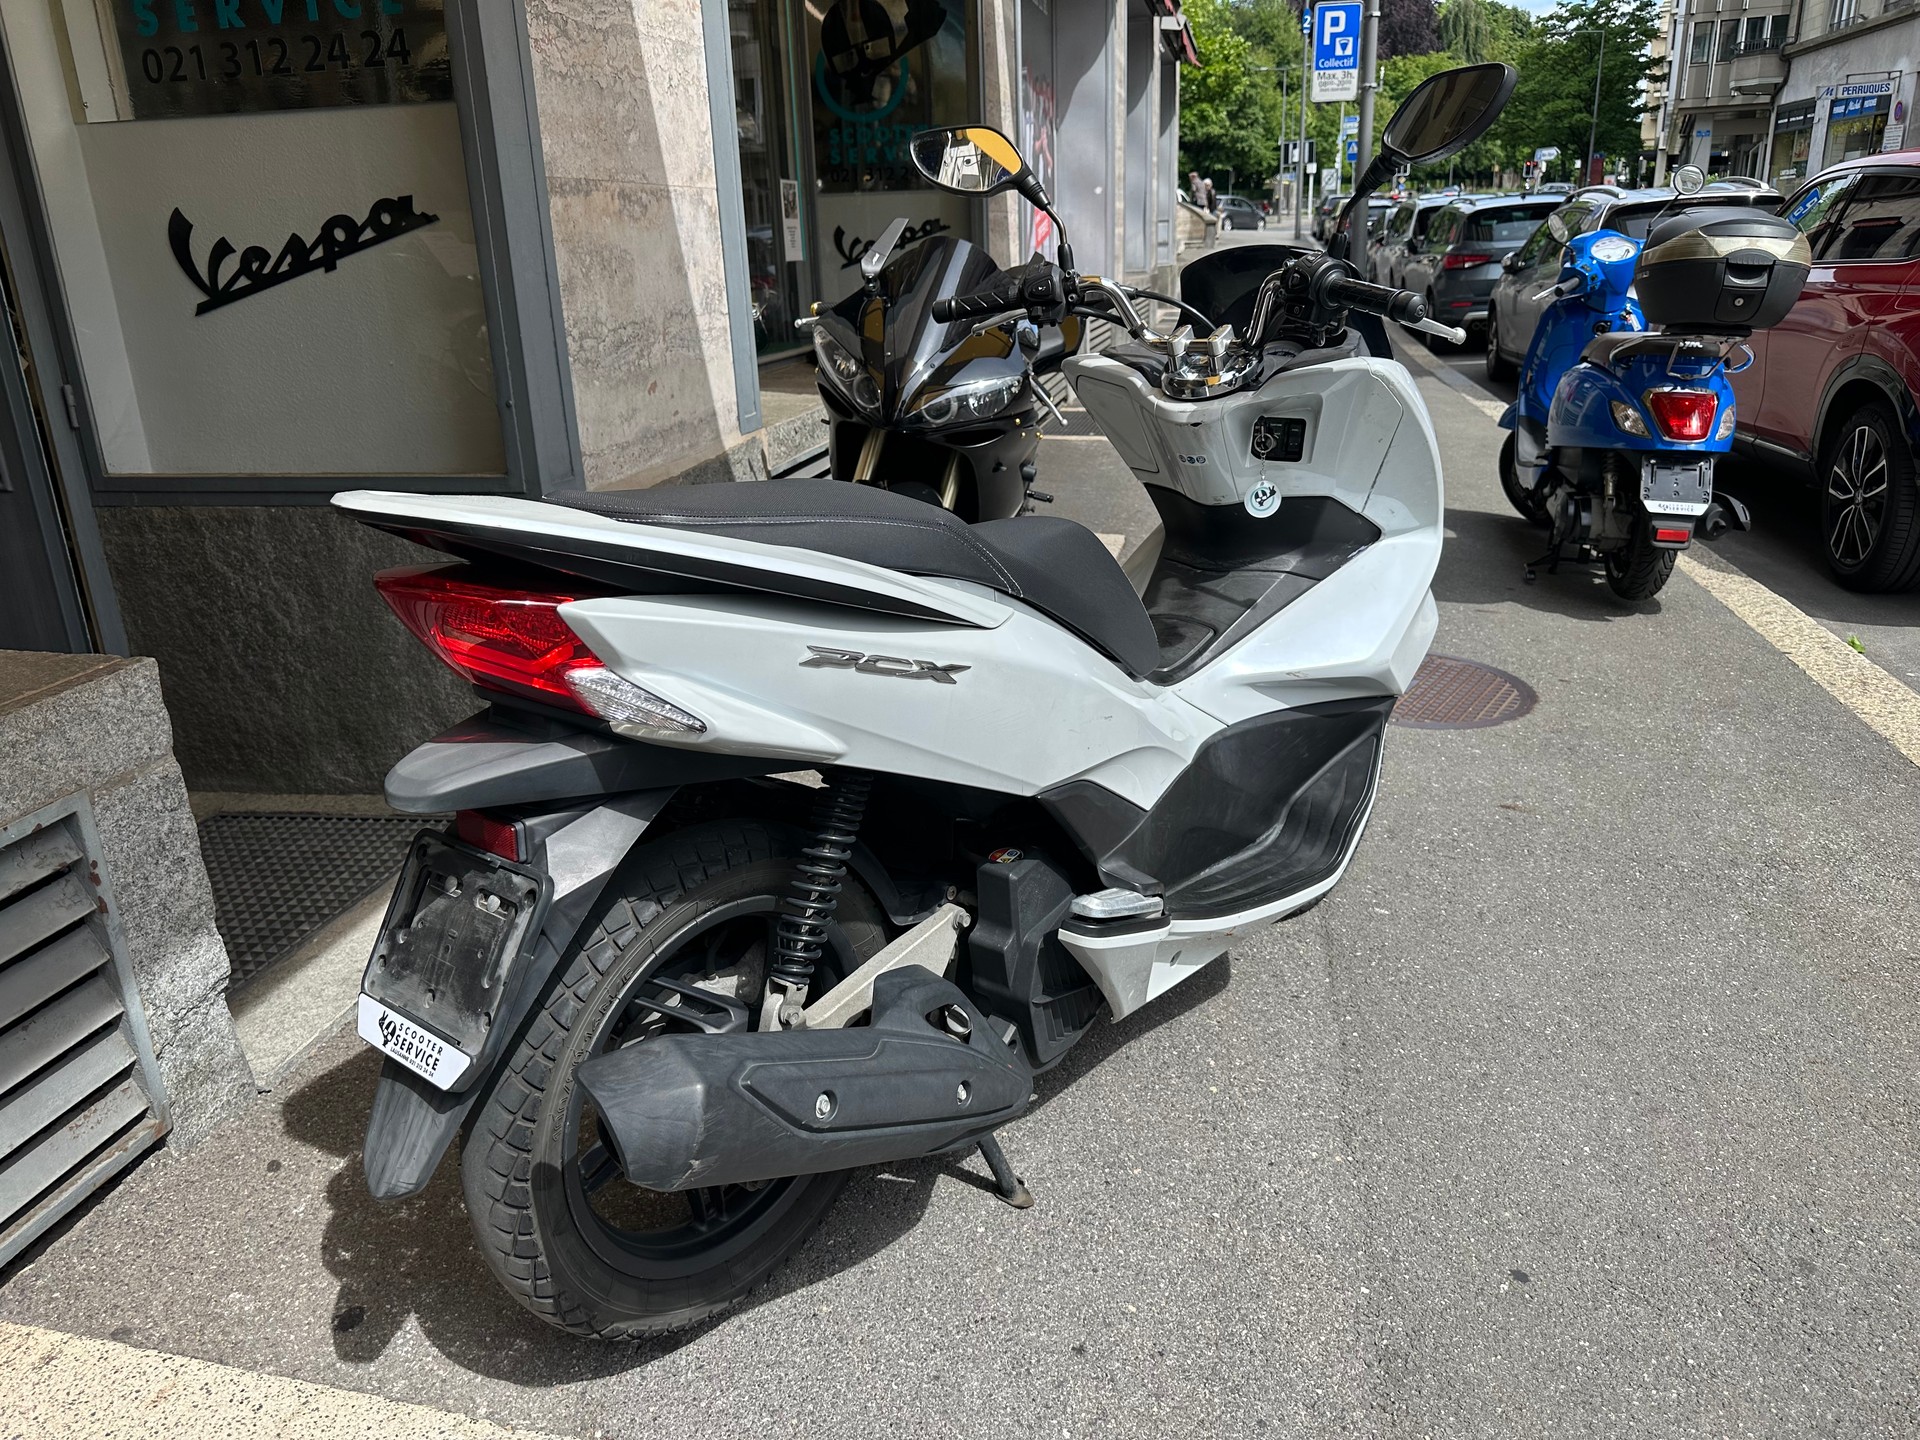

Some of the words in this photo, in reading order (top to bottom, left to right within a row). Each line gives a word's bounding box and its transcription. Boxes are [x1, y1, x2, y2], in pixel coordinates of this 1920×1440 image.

[1323, 10, 1346, 45] P
[142, 45, 208, 84] 021
[220, 38, 292, 80] 312
[302, 32, 350, 72] 24
[360, 28, 411, 68] 24
[1319, 57, 1354, 68] Collectif
[1842, 82, 1891, 96] PERRUQUES
[168, 195, 440, 316] Vespa
[833, 218, 951, 270] Vepa
[799, 645, 972, 685] PCX
[394, 1034, 440, 1071] SERVICE
[399, 1023, 443, 1056] SCOOTER
